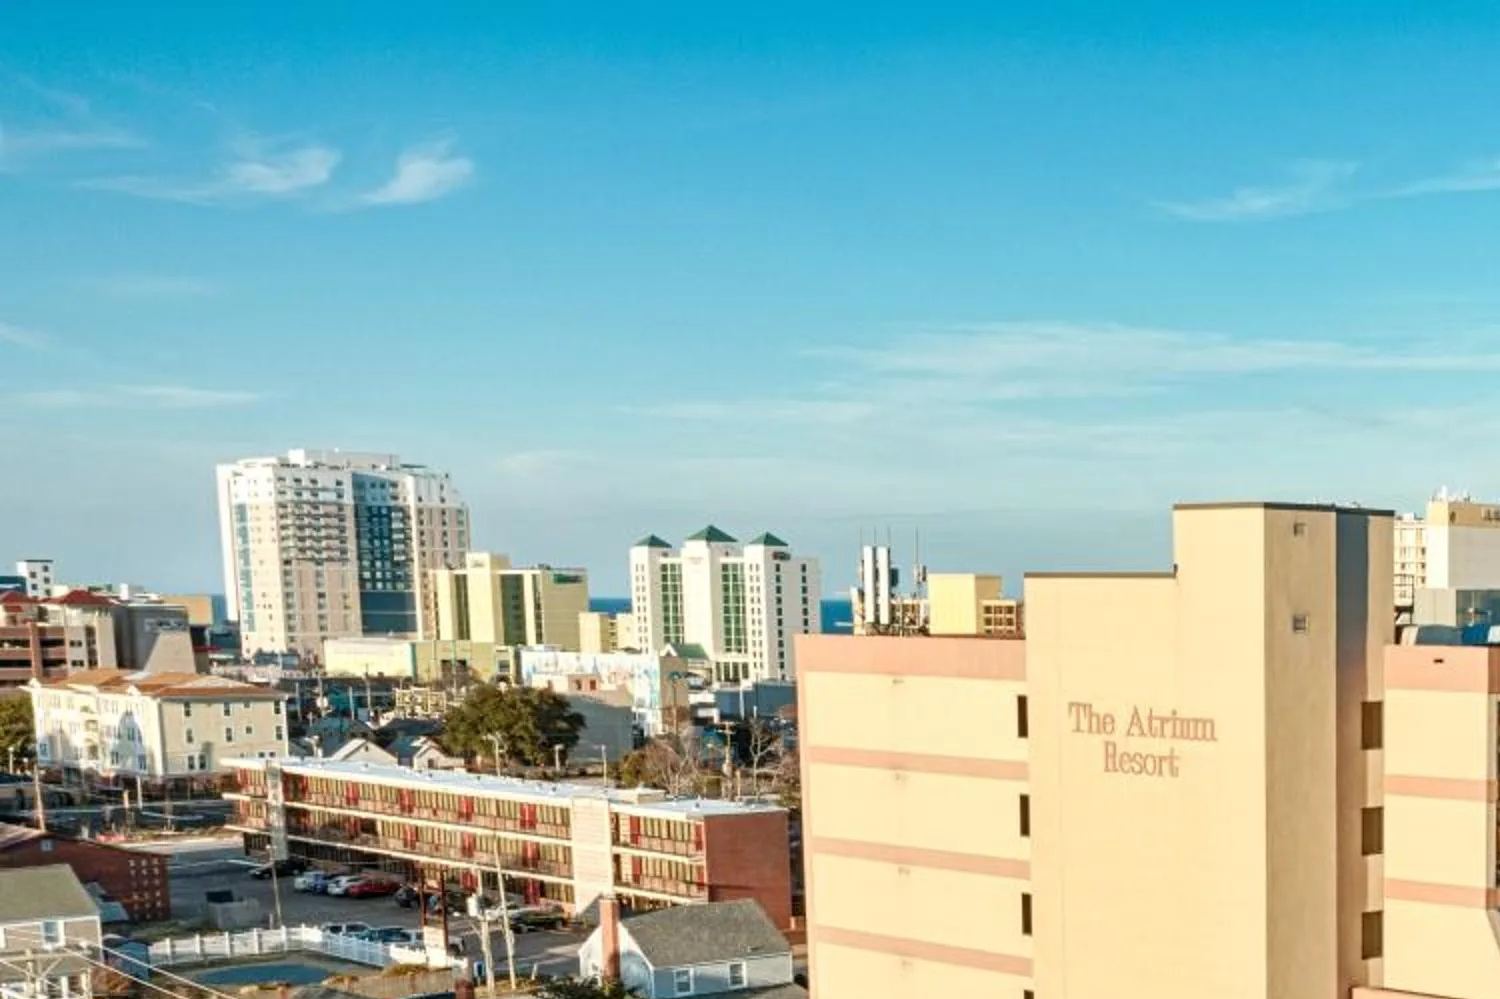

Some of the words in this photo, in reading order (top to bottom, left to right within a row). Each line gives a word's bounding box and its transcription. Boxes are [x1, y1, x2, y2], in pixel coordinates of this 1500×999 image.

[1067, 701, 1116, 736] The
[1126, 704, 1219, 742] Atrium
[1103, 740, 1181, 778] Resort
